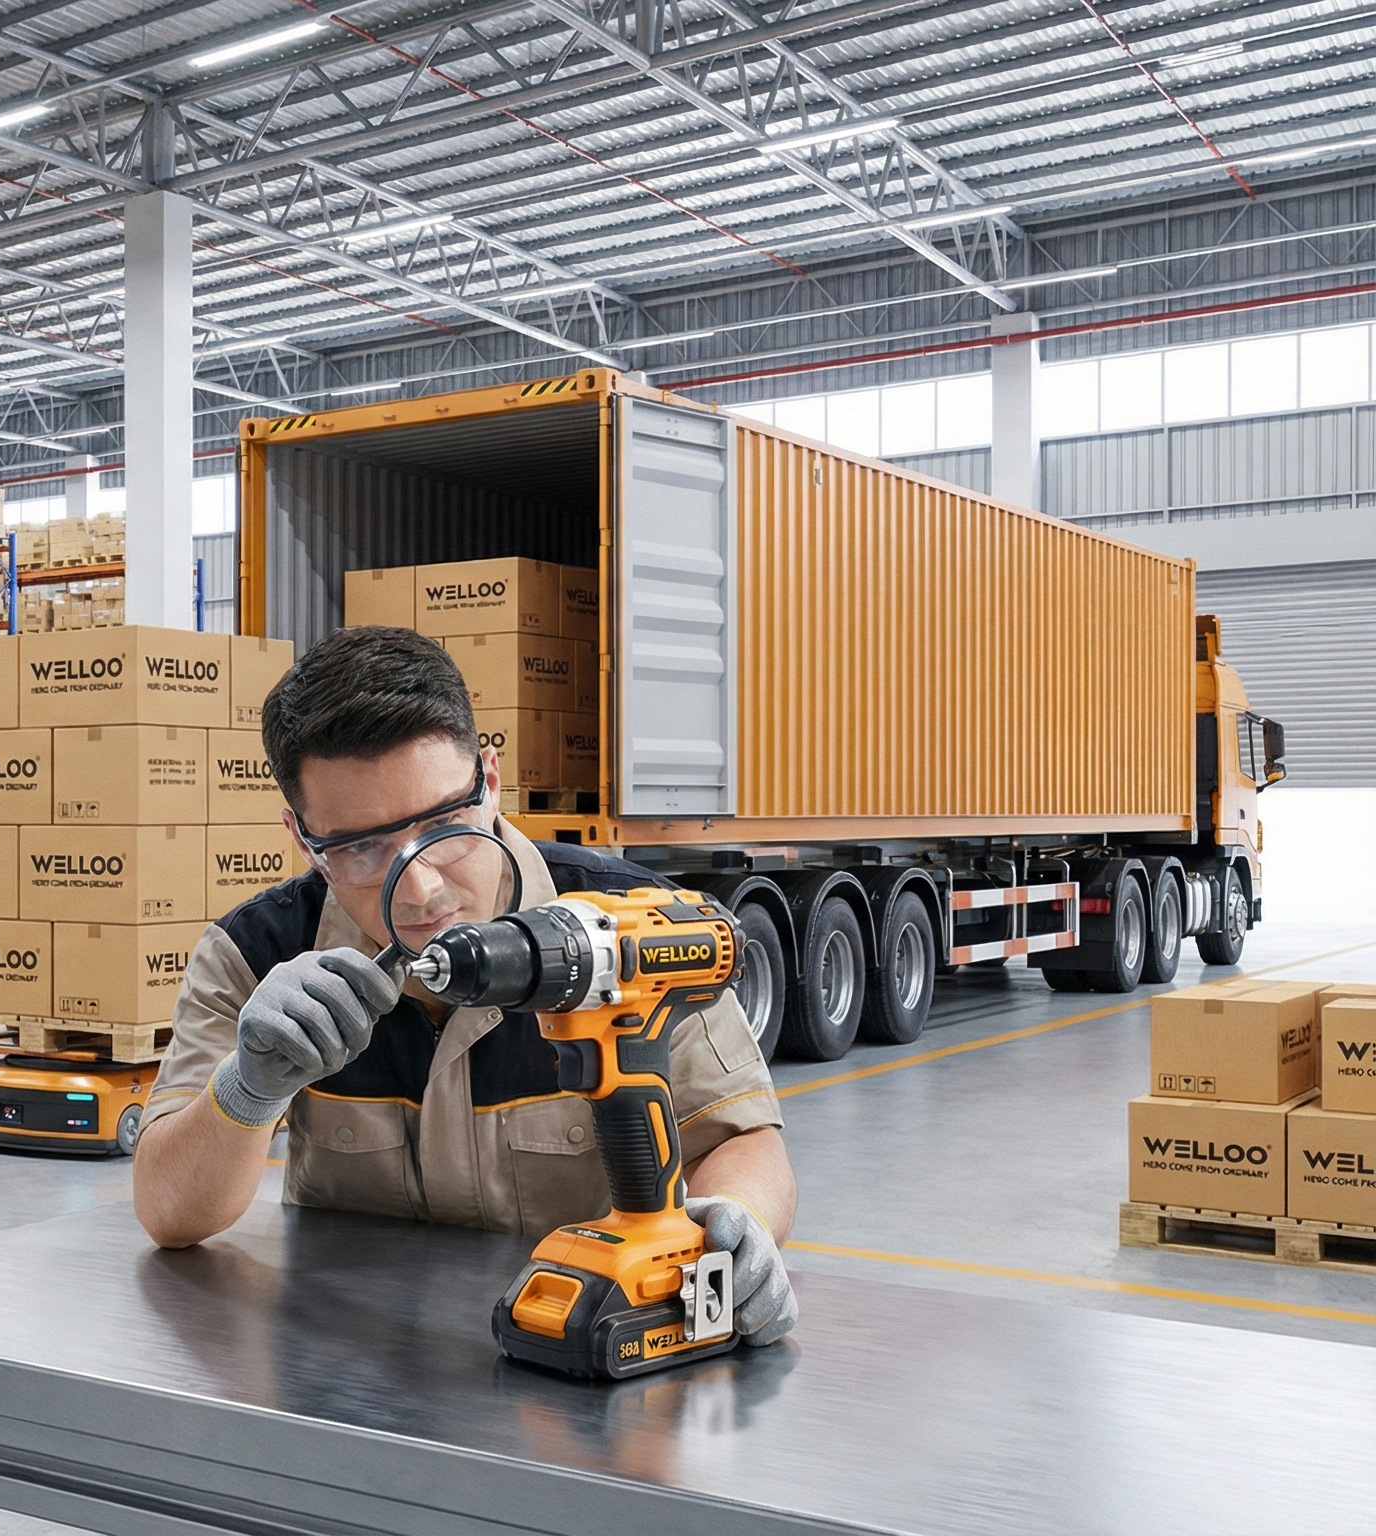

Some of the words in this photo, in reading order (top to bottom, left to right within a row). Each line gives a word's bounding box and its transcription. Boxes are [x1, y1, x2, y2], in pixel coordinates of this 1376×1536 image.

[426, 581, 506, 601] WELLOO
[30, 657, 123, 681] WELLOO
[145, 656, 218, 681] WELLOO
[217, 760, 272, 779] WELLO
[30, 855, 123, 875] WELLOO
[216, 853, 283, 873] WELLOO
[1143, 1137, 1268, 1166] WELLOO
[1303, 1150, 1374, 1174] WEL
